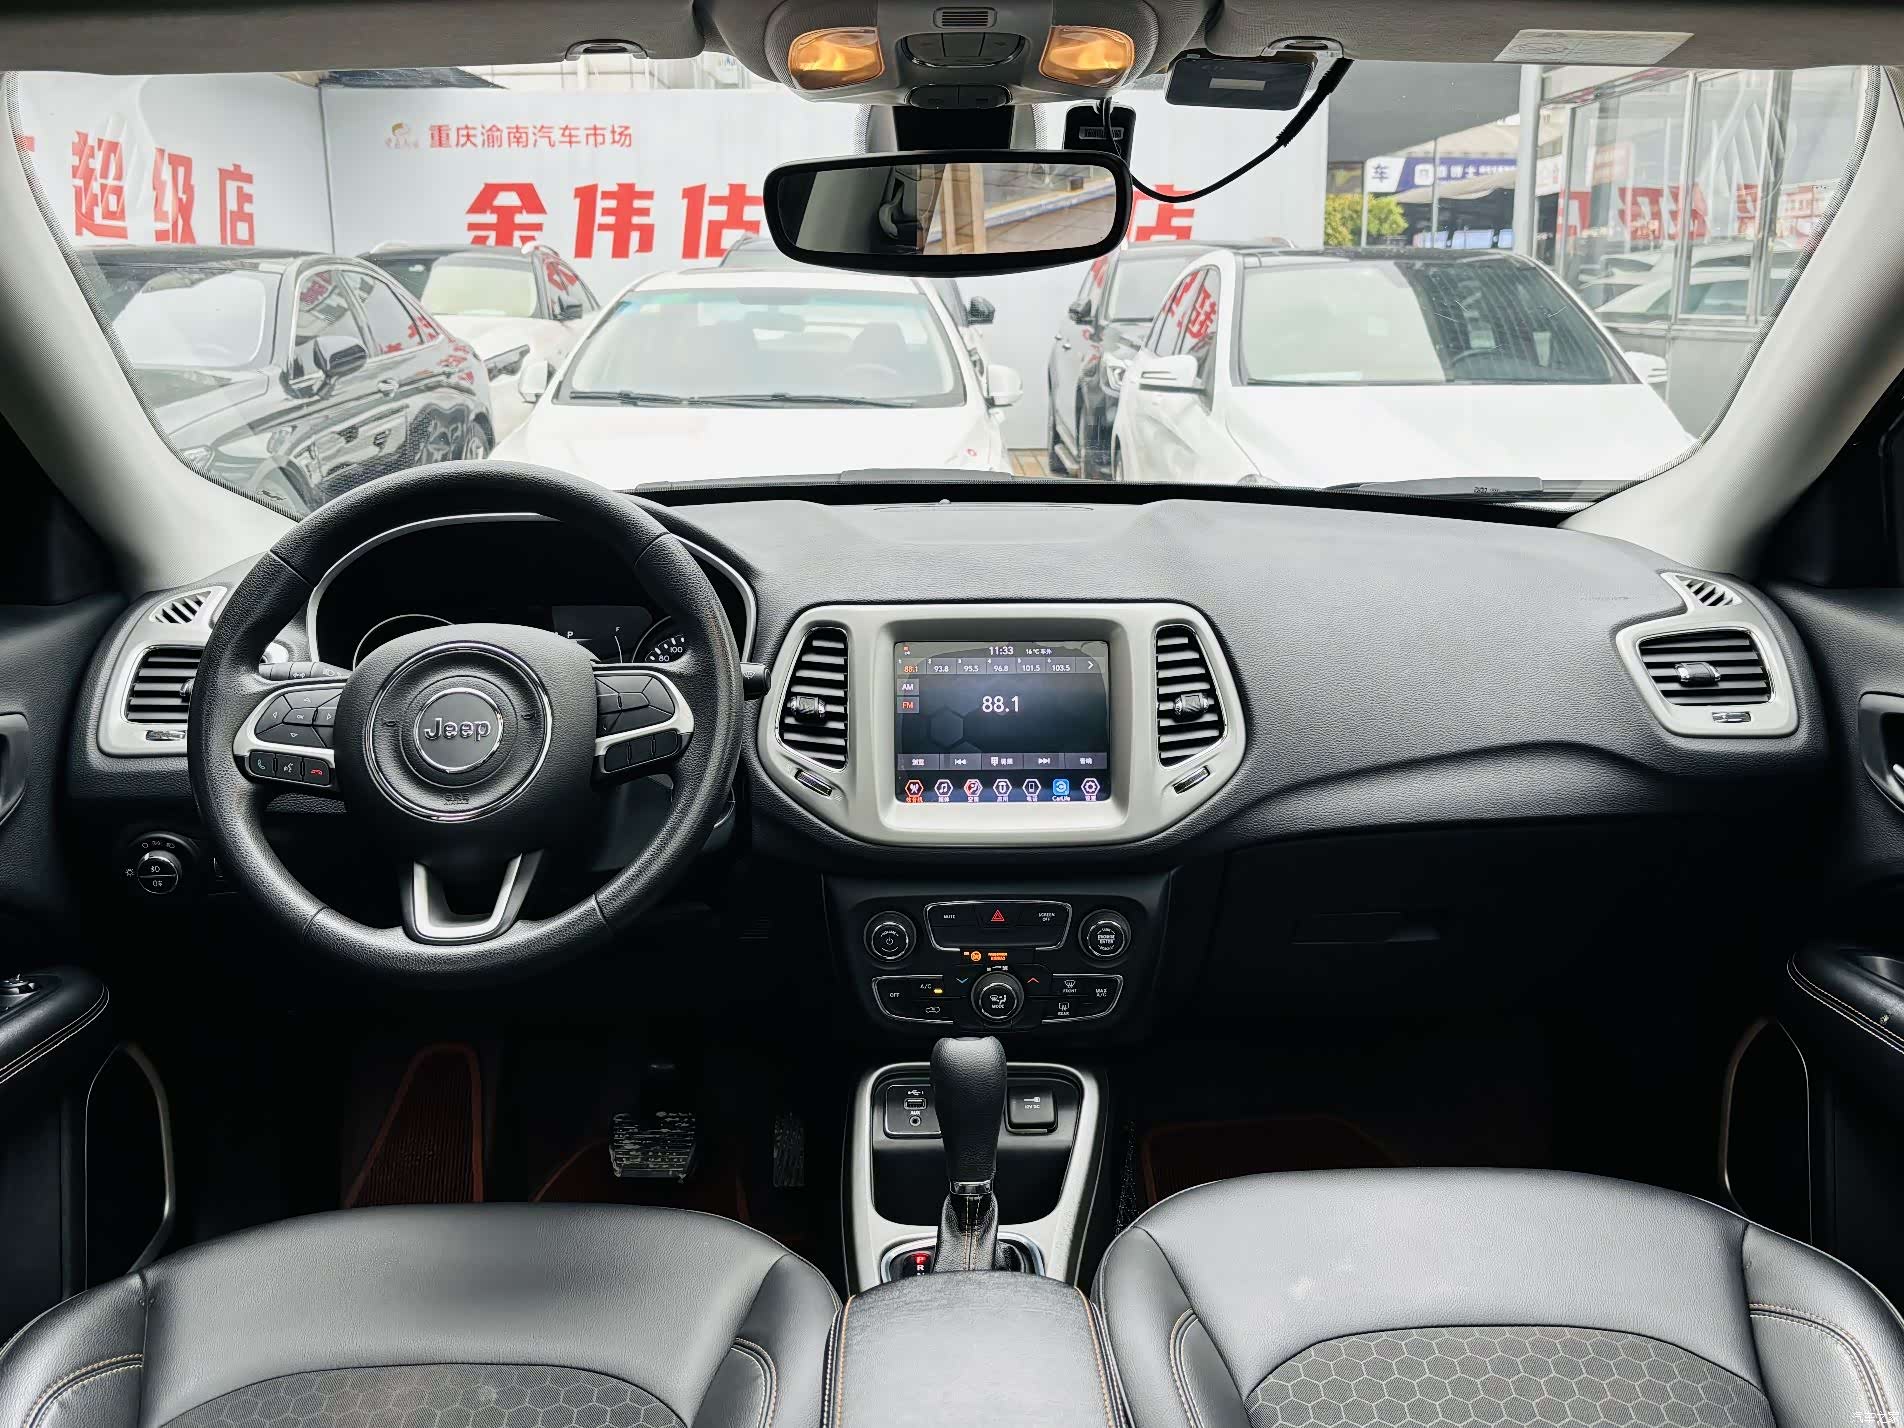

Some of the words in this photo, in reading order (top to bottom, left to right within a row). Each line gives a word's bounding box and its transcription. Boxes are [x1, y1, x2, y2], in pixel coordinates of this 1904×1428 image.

[429, 123, 633, 149] 重庆渝南汽车市场
[17, 130, 255, 246] 超级店
[567, 631, 574, 639] P
[670, 645, 683, 654] 100
[989, 646, 1014, 656] 11:33
[903, 665, 919, 673] 88.1
[933, 665, 949, 673] 93.8
[963, 665, 979, 673] 95.5
[993, 664, 1009, 672] 96.8
[1022, 664, 1041, 672] 101.5
[1051, 664, 1071, 672] 103.5
[901, 683, 914, 692] AM
[902, 701, 914, 710] FM
[981, 695, 1020, 713] 88.1
[423, 717, 492, 741] Jeep
[916, 1256, 926, 1264] P
